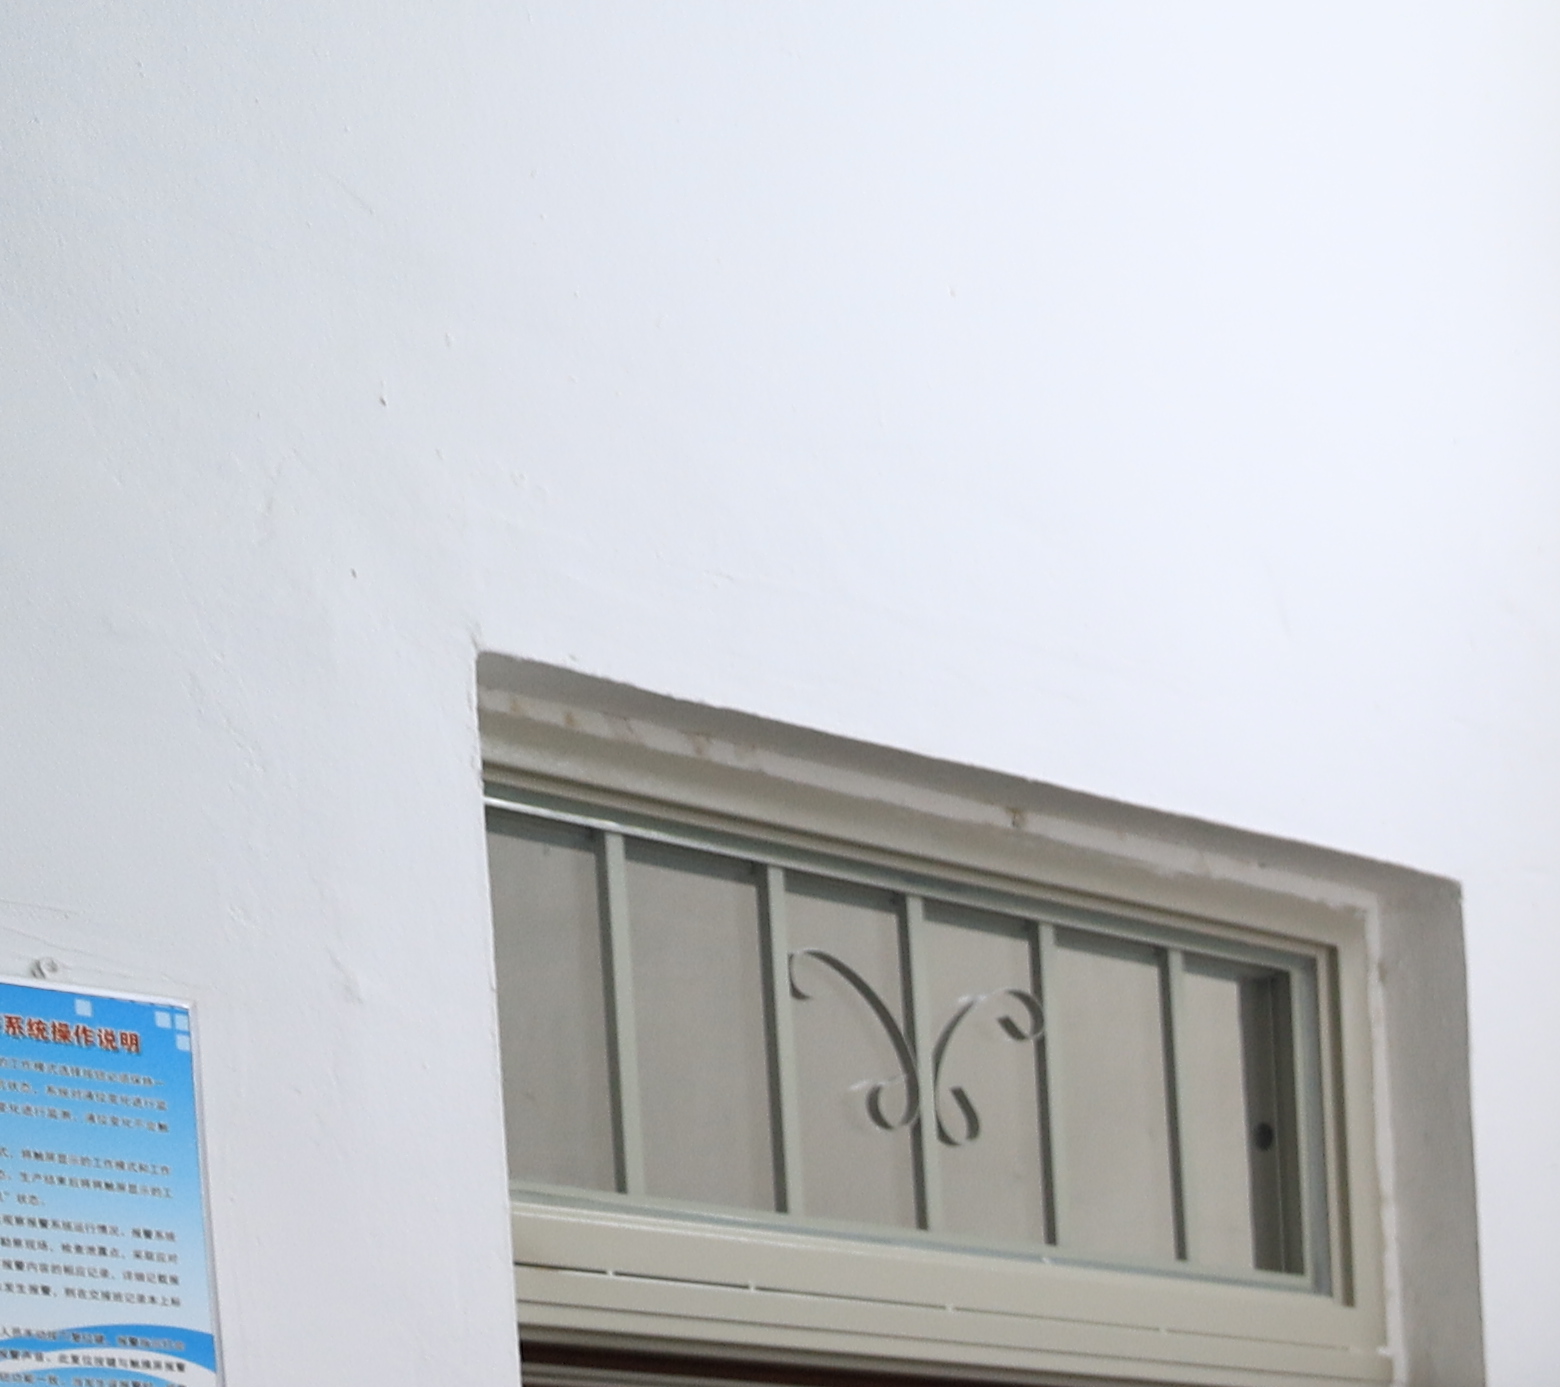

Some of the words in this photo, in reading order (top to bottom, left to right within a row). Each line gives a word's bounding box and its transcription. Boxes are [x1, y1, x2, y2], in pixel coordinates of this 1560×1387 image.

[3, 1014, 140, 1054] 系统操作说明
